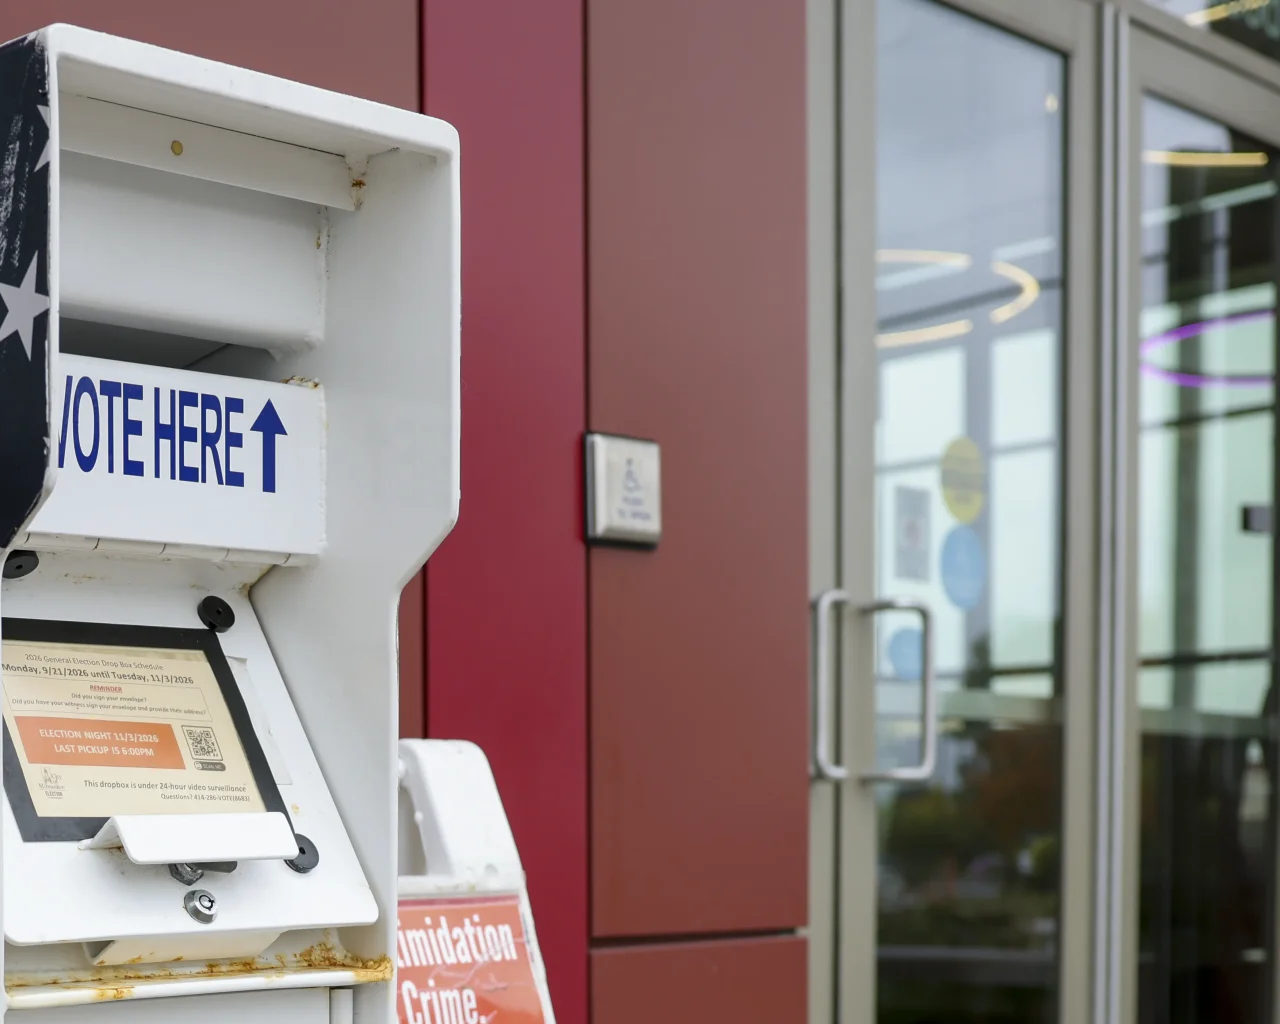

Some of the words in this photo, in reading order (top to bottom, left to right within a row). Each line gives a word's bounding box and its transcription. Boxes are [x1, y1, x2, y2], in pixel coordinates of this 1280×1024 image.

[154, 386, 245, 488] HERE
[25, 653, 42, 662] 2026
[43, 656, 71, 664] General
[72, 658, 100, 666] Election
[101, 660, 119, 669] Drop
[133, 662, 164, 671] Schedule
[1, 663, 41, 675] Monday,
[42, 666, 89, 677] 9/21/2026
[90, 669, 110, 679] until
[110, 671, 149, 683] Tuesday,
[150, 674, 194, 684] 11/3/2026
[89, 684, 123, 693] REMINDER
[93, 694, 105, 702] sign
[50, 700, 64, 708] your
[86, 702, 99, 710] sign
[39, 729, 82, 739] ELECTION
[84, 731, 112, 740] NIGHT
[113, 732, 159, 743] 11/3/2026
[54, 744, 75, 753] LAST
[77, 745, 109, 754] PICKUP
[112, 746, 120, 755] IS
[121, 747, 155, 757] 6:00PM
[84, 780, 99, 788] This
[100, 780, 129, 790] dropbox
[137, 782, 158, 790] under
[159, 782, 186, 791] 24-hour
[397, 913, 518, 968] imidation
